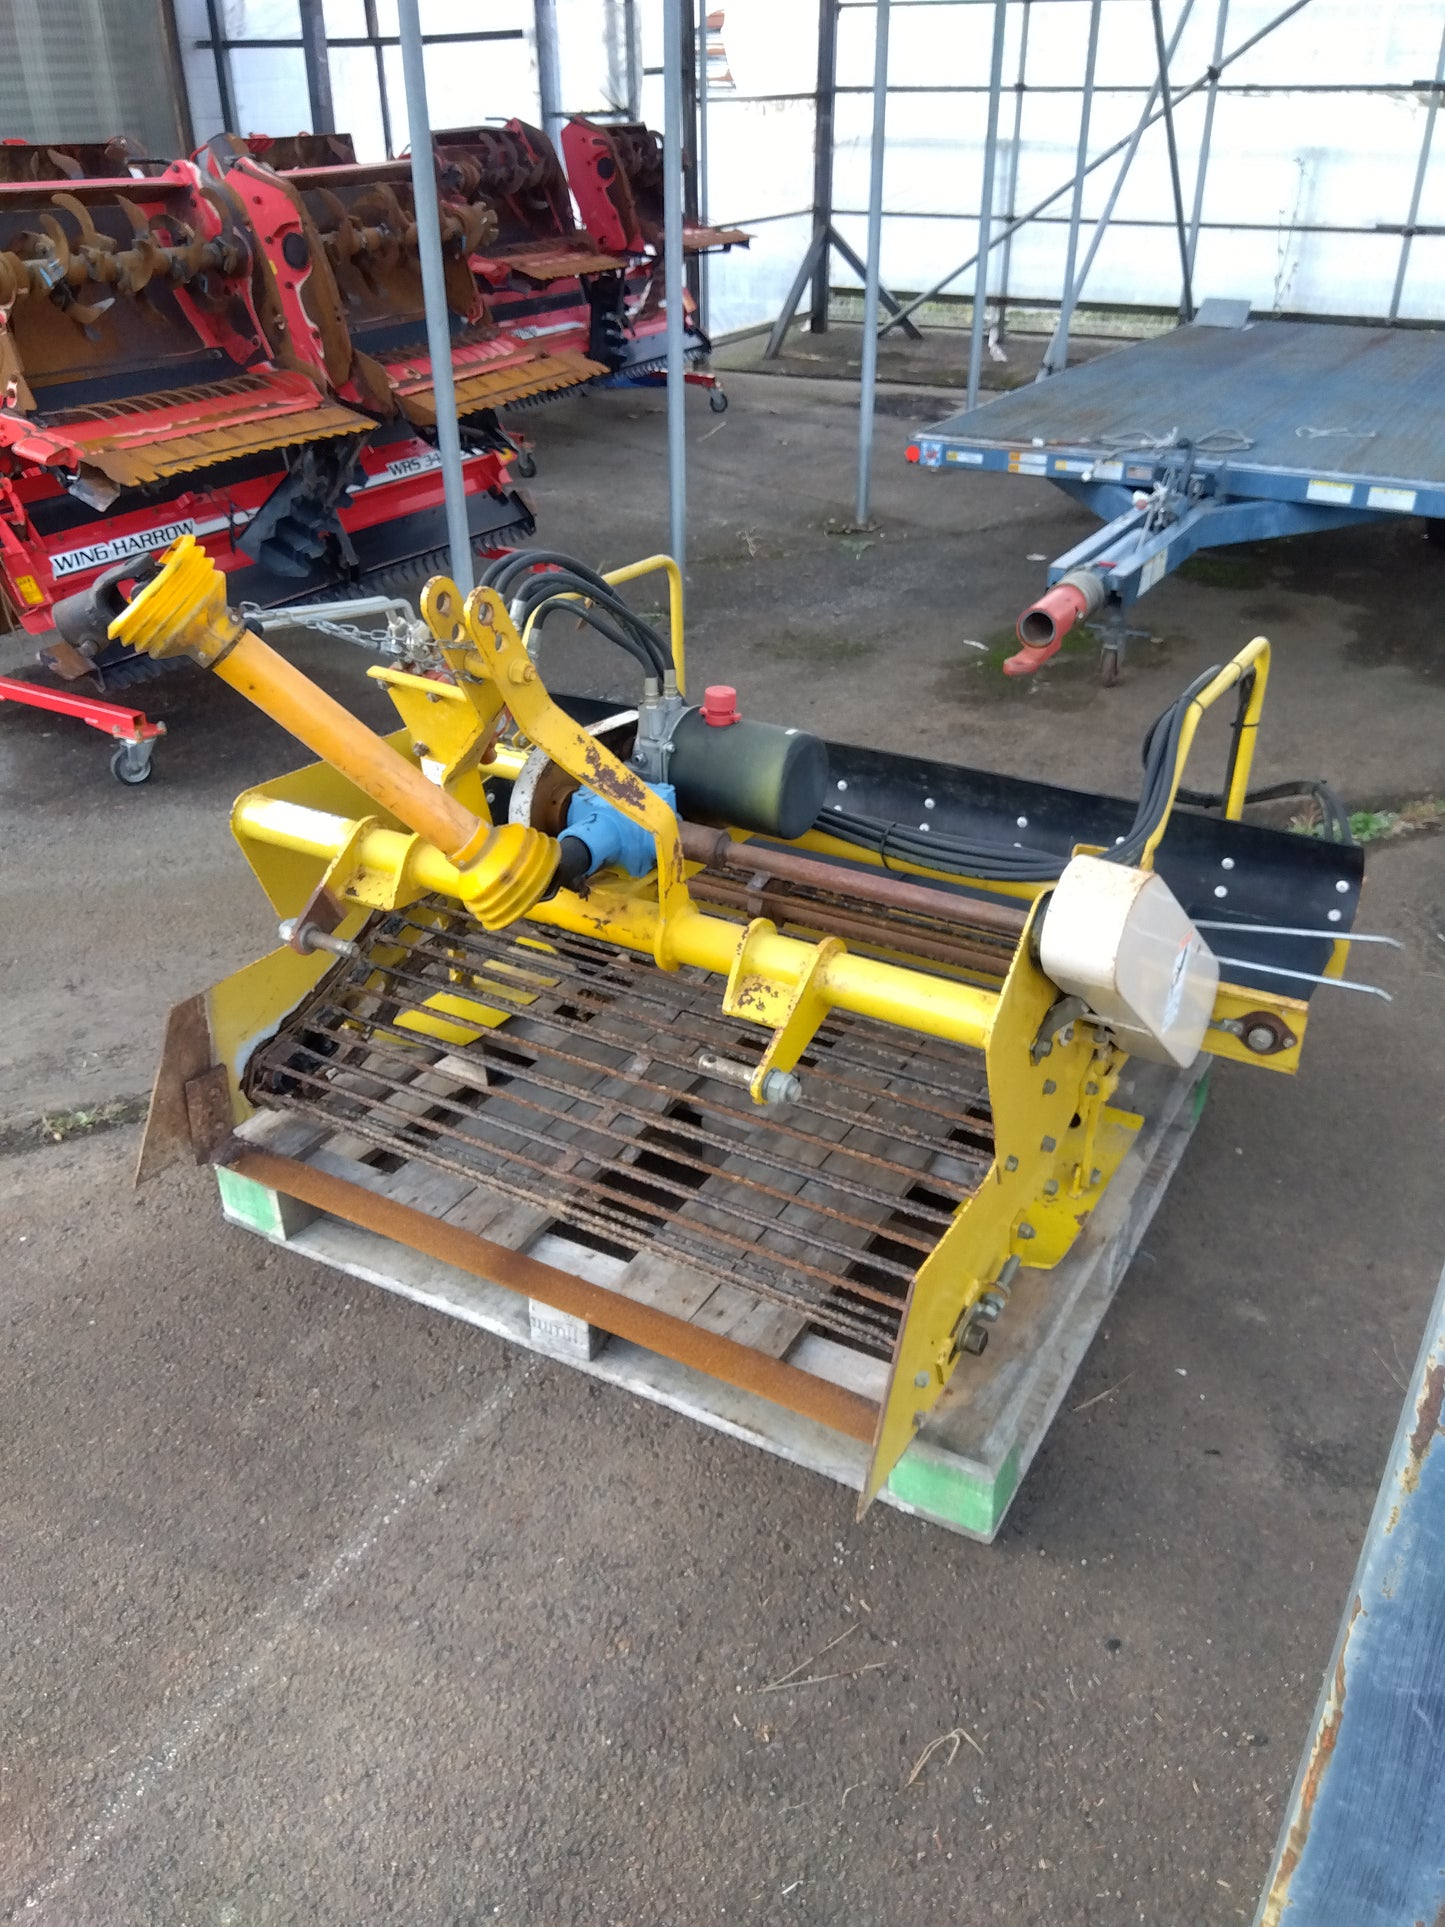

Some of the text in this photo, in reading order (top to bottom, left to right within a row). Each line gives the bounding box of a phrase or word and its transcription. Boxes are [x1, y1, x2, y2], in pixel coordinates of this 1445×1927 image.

[387, 458, 421, 476] WRS
[54, 520, 194, 571] WING HARROW
